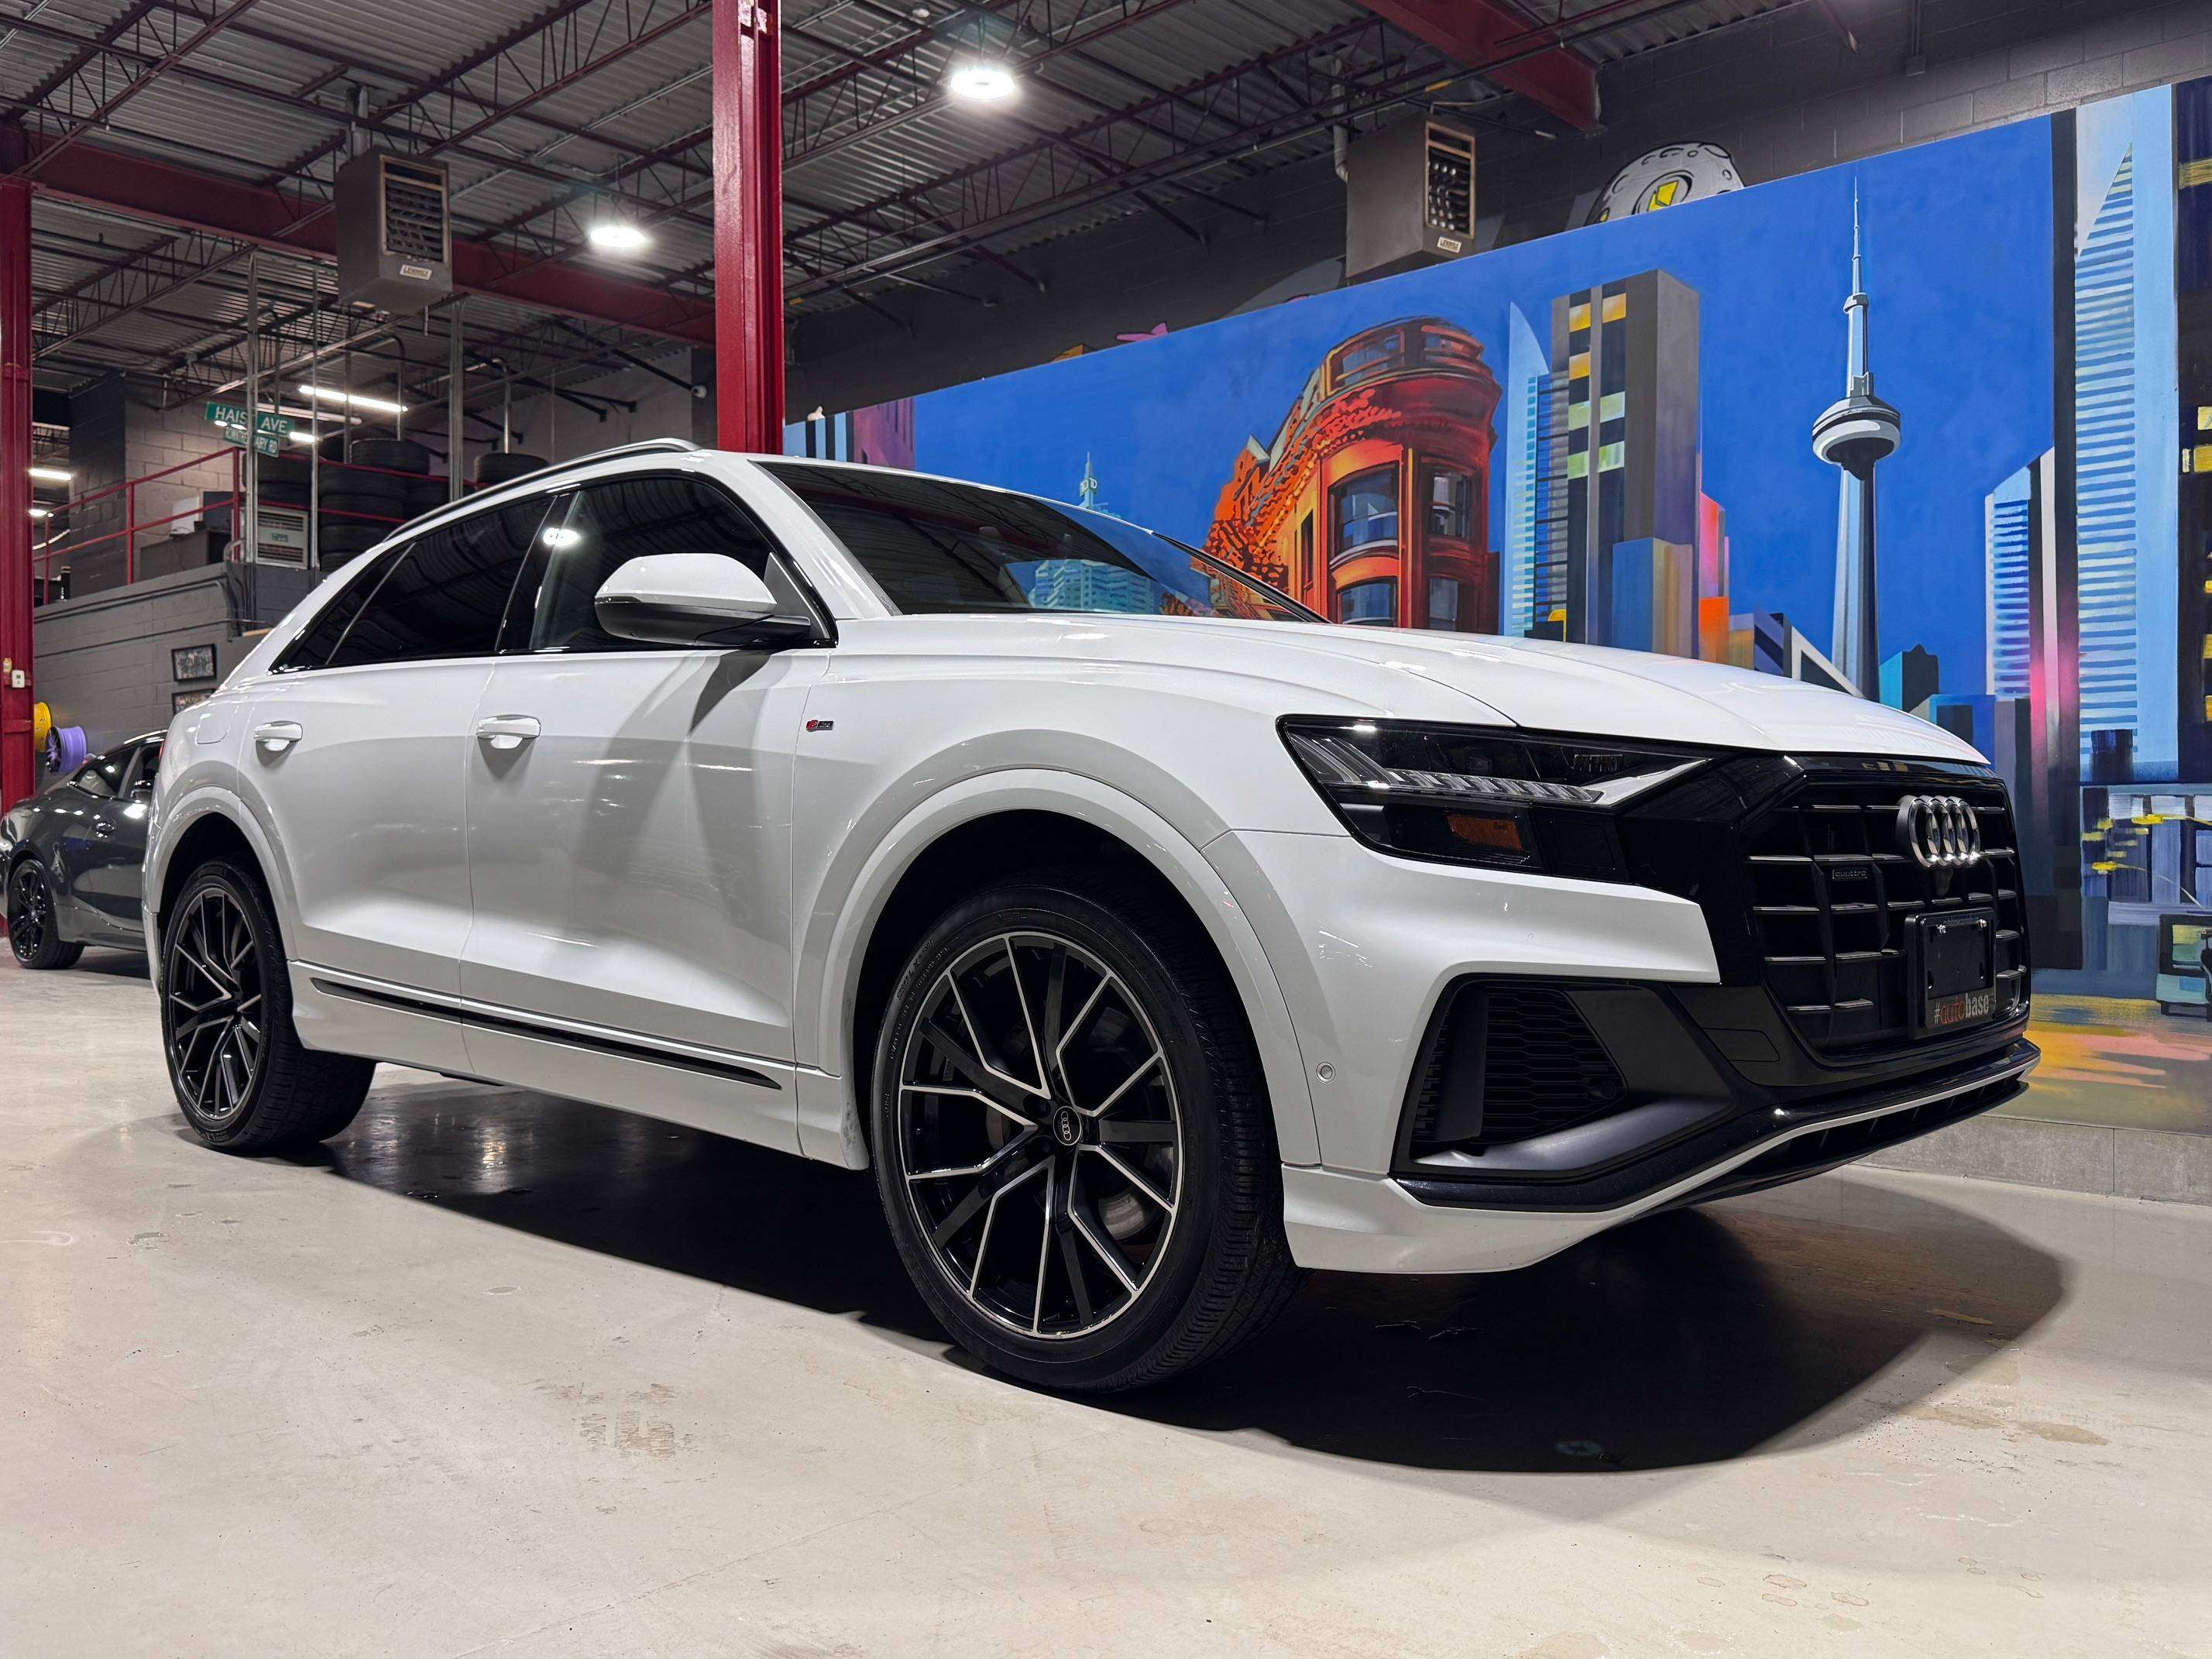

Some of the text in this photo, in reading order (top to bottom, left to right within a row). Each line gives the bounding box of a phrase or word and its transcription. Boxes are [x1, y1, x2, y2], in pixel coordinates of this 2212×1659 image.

[215, 406, 287, 433] HAIS AVE
[1933, 992, 1990, 1025] #autobase
